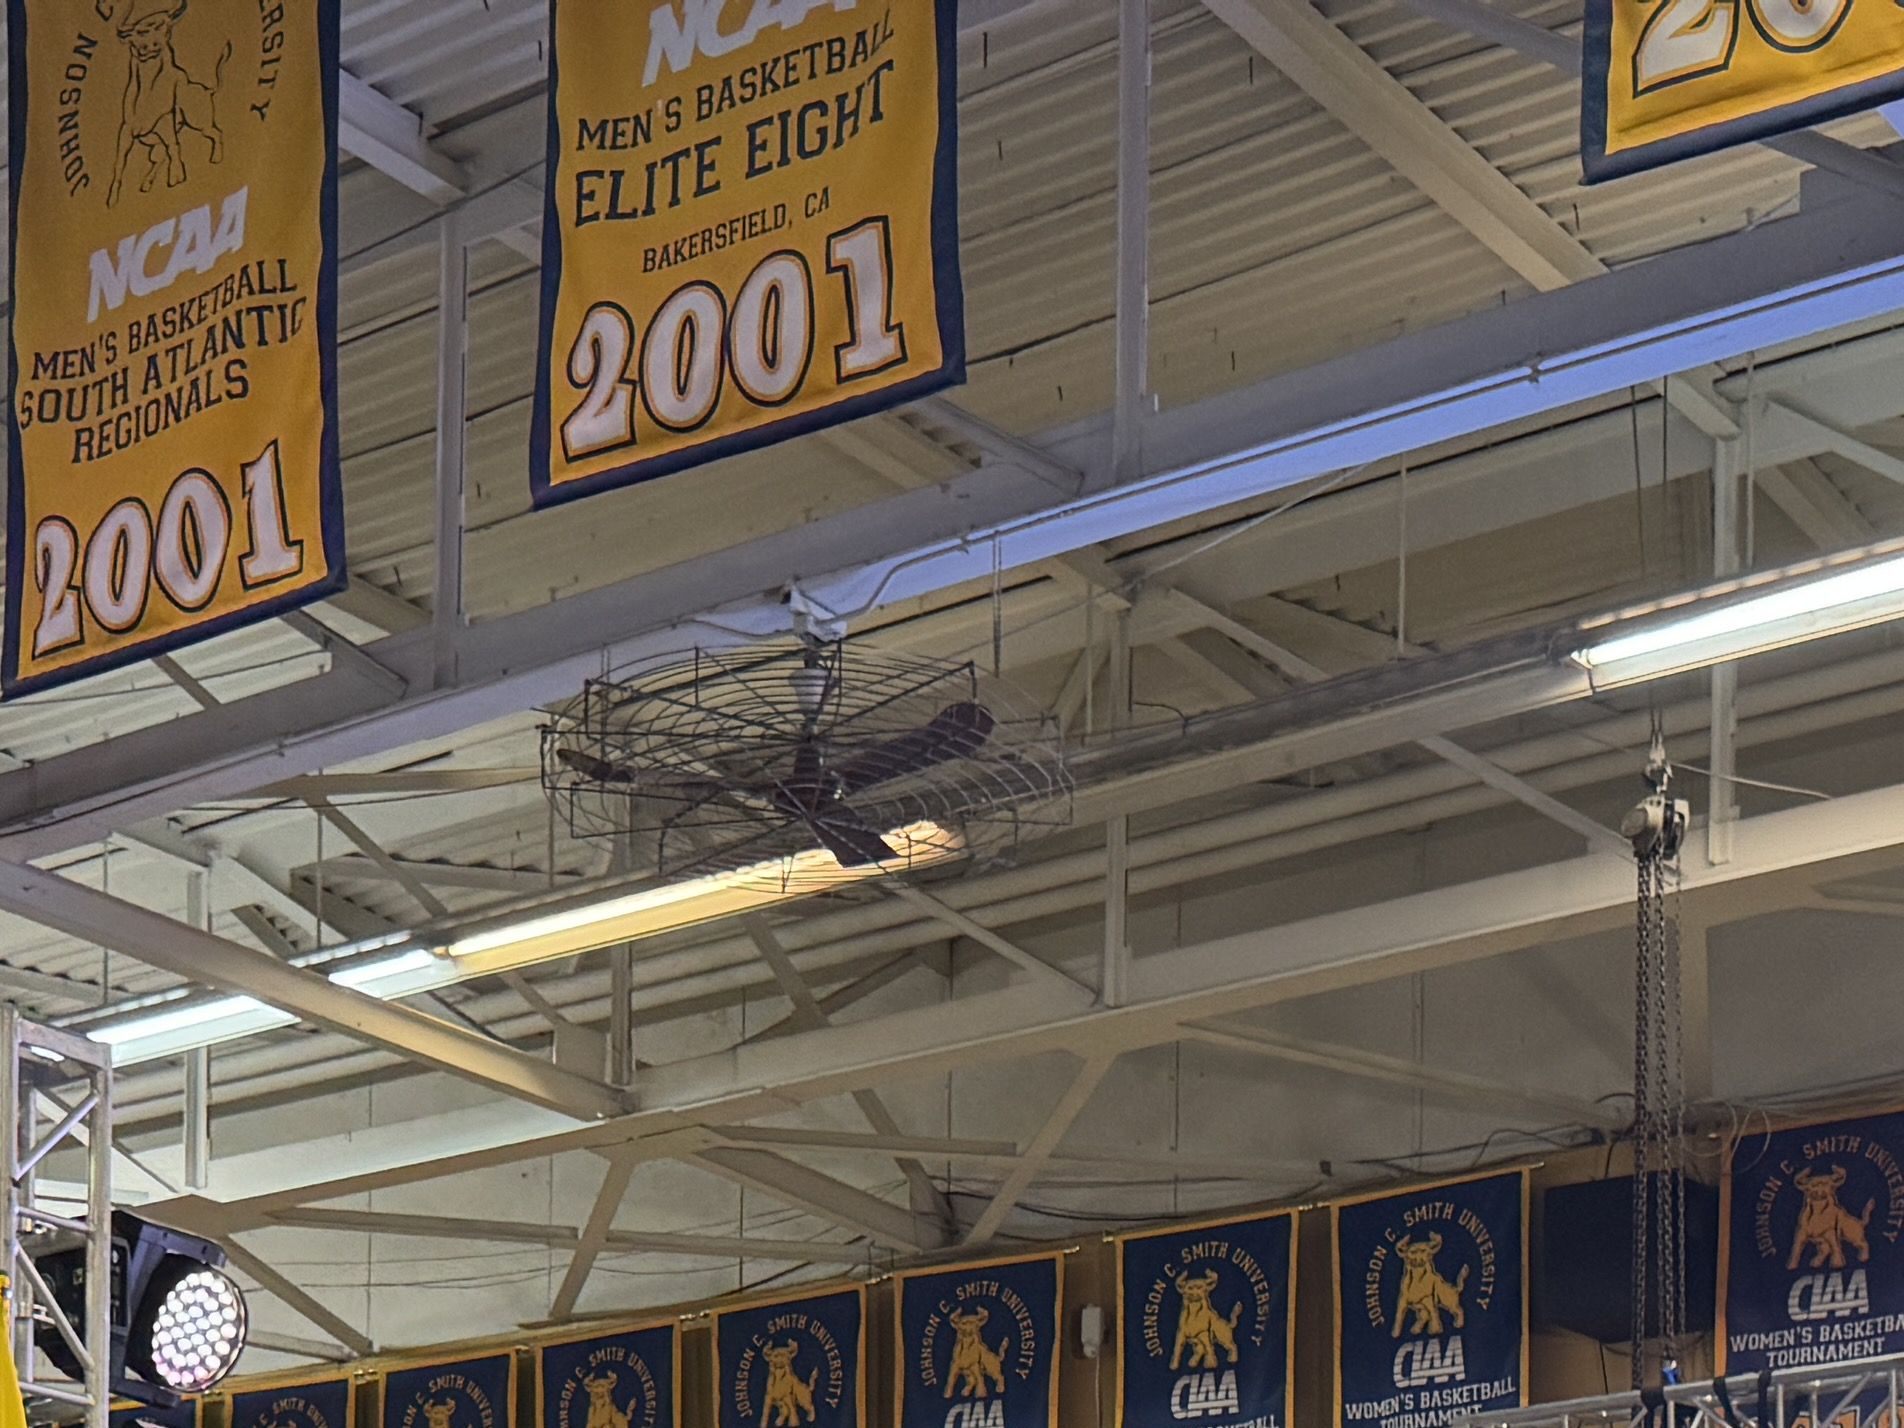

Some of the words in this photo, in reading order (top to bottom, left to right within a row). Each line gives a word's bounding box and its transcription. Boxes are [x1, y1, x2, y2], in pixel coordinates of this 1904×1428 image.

[576, 96, 682, 152] MEN'S
[696, 8, 894, 122] BASKETBALL
[641, 0, 858, 87] NC
[58, 32, 98, 197] JOHNSON
[575, 135, 722, 229] ELITE
[745, 58, 894, 180] EIGHT
[87, 185, 248, 324] NCAA
[642, 202, 794, 273] BAKERSFIELD,
[803, 186, 831, 219] CA
[21, 367, 128, 430] SOUTH
[142, 296, 307, 395] ATLANTIC
[31, 331, 118, 382] MEN'S
[128, 258, 298, 354] BASKETBALL
[560, 214, 908, 464] 2001
[71, 358, 250, 464] REGIONALS
[32, 437, 304, 661] 2001
[1802, 1135, 1862, 1160] SMITH
[1144, 1279, 1167, 1358] JOHNSON
[1181, 1240, 1230, 1265] SMITH
[1231, 1247, 1271, 1348] UNIVERSITY
[1365, 1245, 1388, 1329] JOHNSON
[1403, 1200, 1455, 1229] SMITH
[1457, 1207, 1496, 1311] UNIVERSITY
[1788, 1268, 1870, 1322] CIAA
[588, 1345, 627, 1368] SMITH
[767, 1312, 808, 1335] SMITH
[809, 1319, 844, 1409] UNIVERSITY
[955, 1279, 1000, 1302] SMITH
[1000, 1285, 1036, 1382] UNIVERSITY
[1393, 1335, 1466, 1389] CIAA
[1730, 1325, 1813, 1353] WOMEN'S
[1767, 1337, 1886, 1368] TOURNAMENT
[428, 1373, 465, 1393] SMITH
[1171, 1368, 1240, 1420] CIAA
[1345, 1391, 1415, 1421] WOMEN'S
[1419, 1375, 1517, 1410] BASKETBALL
